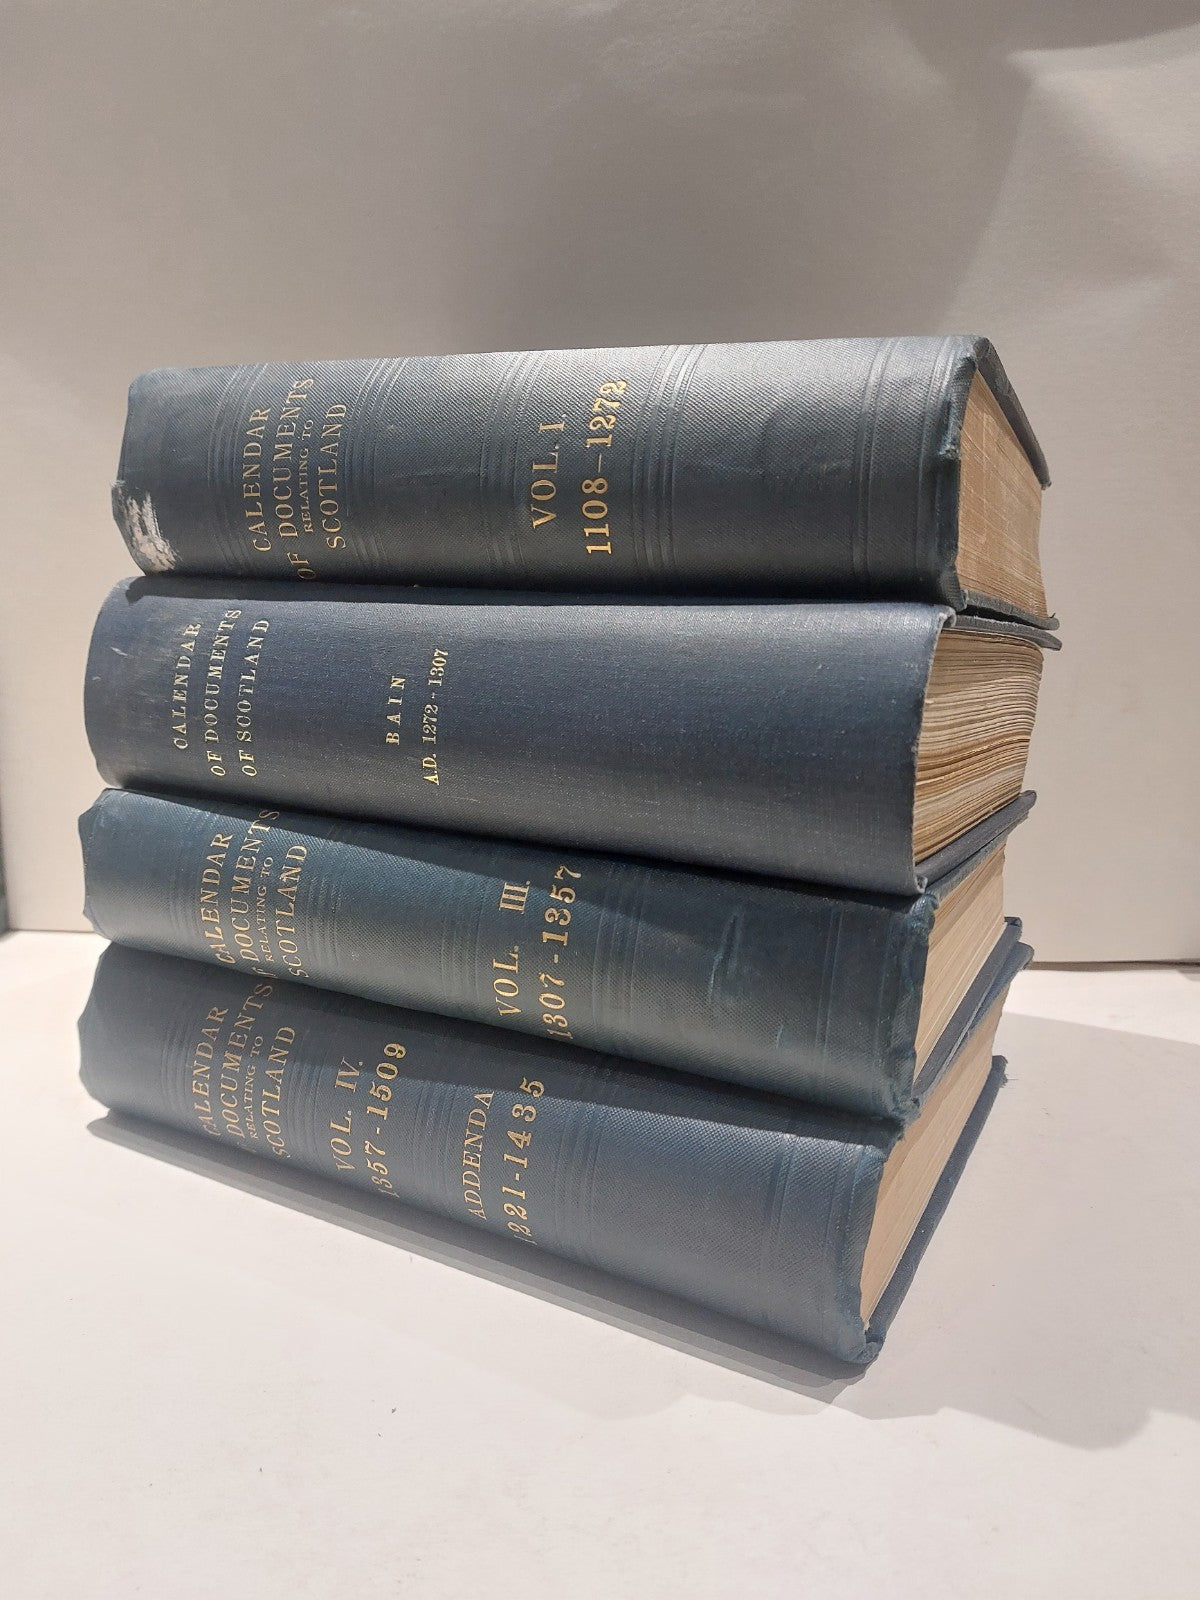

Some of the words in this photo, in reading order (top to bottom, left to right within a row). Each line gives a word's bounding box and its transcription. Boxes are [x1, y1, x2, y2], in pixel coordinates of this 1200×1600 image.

[272, 378, 314, 538] DOCUMENTS
[302, 419, 314, 440] TO
[539, 413, 567, 433] I.
[242, 407, 272, 551] CALENDAR
[299, 447, 314, 533] RELATING
[317, 404, 347, 549] SCOTLAND
[530, 443, 560, 529] VOL.
[287, 552, 317, 580] OF
[172, 623, 201, 749] CALENDAR
[204, 609, 242, 743] DOCUMENTS
[236, 620, 270, 742] SCOTLAND
[428, 648, 449, 686] 1307
[385, 675, 406, 745] BAIN
[422, 704, 439, 745] 1272
[206, 751, 226, 777] OF
[239, 750, 258, 777] OF
[422, 753, 440, 786] A.D.
[201, 833, 236, 964] CALENDAR
[230, 809, 280, 963] DOCUMENTS
[260, 856, 274, 878] TO
[499, 880, 531, 914] III.
[256, 885, 275, 963] RELATING
[275, 845, 310, 978] SCOTLAND
[492, 945, 522, 1016] VOL.
[192, 1006, 230, 1136] CALENDAR
[220, 983, 273, 1139] DOCUMENTS
[251, 1035, 264, 1057] TO
[335, 1056, 364, 1093] IV.
[244, 1065, 259, 1140] RELATING
[261, 1026, 296, 1158] SCOTLAND
[330, 1110, 356, 1171] VOL.
[462, 1091, 495, 1221] ADDENDA
